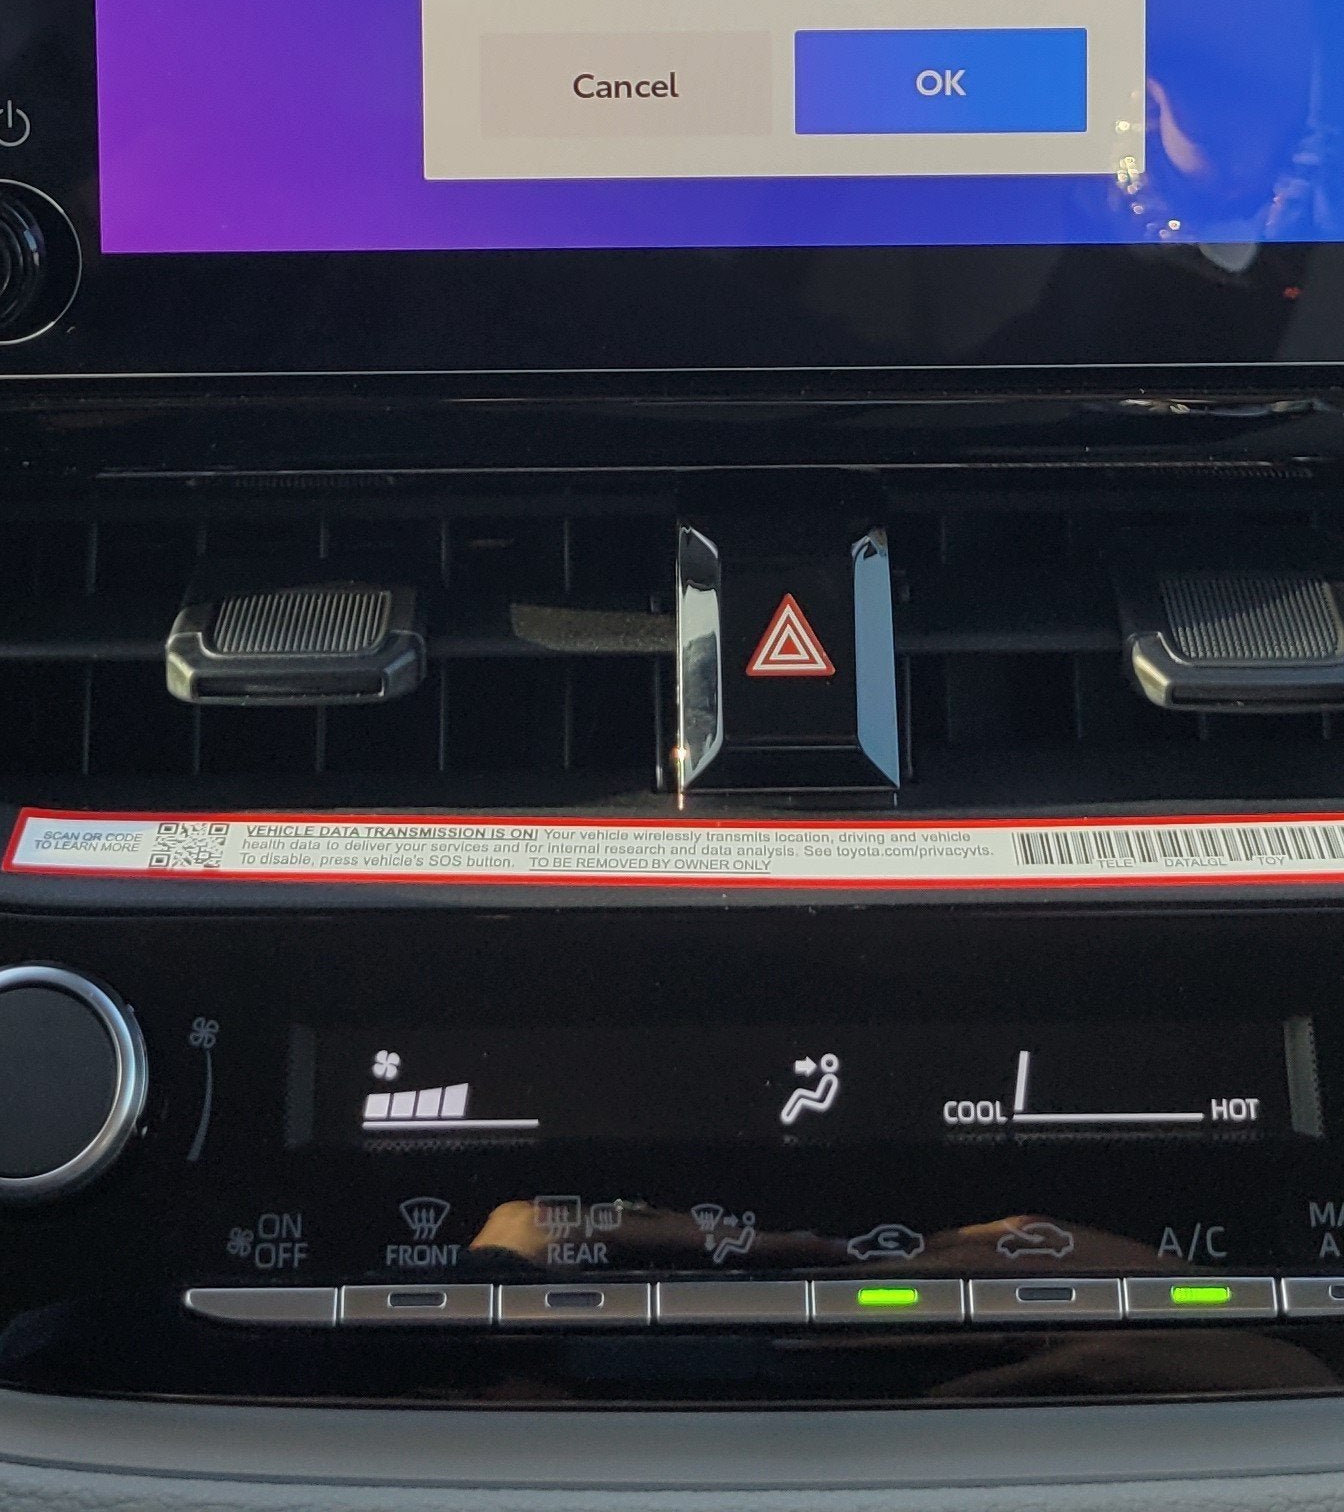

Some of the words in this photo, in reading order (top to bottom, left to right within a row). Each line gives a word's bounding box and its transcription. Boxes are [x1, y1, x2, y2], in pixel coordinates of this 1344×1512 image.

[573, 71, 680, 99] Cancel
[915, 68, 967, 97] OK
[34, 839, 52, 850] TO
[54, 840, 98, 851] LEARN
[100, 841, 140, 852] MORE
[43, 830, 81, 841] SCAN
[83, 831, 102, 841] QR
[105, 832, 143, 843] CODE
[247, 825, 315, 837] VEHICLE
[319, 826, 360, 838] DATA
[366, 827, 486, 839] TRANSMISSION
[491, 828, 506, 839] IS
[544, 829, 576, 840] Your
[579, 829, 629, 841] vehicle
[633, 830, 702, 843] wirelessly
[705, 831, 770, 843] transmits
[774, 831, 835, 845] location,
[839, 831, 886, 845] driving
[890, 831, 916, 843] and
[921, 830, 971, 843] vehicle
[242, 838, 286, 850] health
[289, 839, 321, 850] data
[326, 840, 339, 851] to
[344, 839, 390, 851] deliver
[395, 842, 426, 854] your
[430, 842, 489, 853] services
[493, 842, 520, 853] and
[524, 842, 544, 853] for
[547, 843, 600, 854] internal
[604, 843, 666, 855] research
[670, 844, 697, 855] and
[701, 844, 732, 856] data
[737, 844, 799, 858] analysis.
[803, 845, 833, 857] See
[240, 852, 256, 865] To
[260, 852, 316, 867] disable,
[319, 854, 359, 867] press
[364, 854, 424, 867] vehicle's
[429, 855, 462, 867] SOS
[467, 855, 515, 868] button.
[529, 857, 549, 868] TO
[553, 857, 573, 868] BE
[576, 858, 648, 869] REMOVED
[651, 858, 671, 869] BY
[674, 858, 731, 870] OWNER
[733, 859, 772, 870] ONLY
[1097, 858, 1134, 869] TELE
[1256, 855, 1286, 866] TOY
[943, 1100, 1008, 1125] COOL
[1210, 1097, 1260, 1122] HOT
[257, 1213, 303, 1240] ON
[547, 1242, 609, 1265] REAR
[1157, 1222, 1228, 1262] A/C
[254, 1241, 309, 1269] OFF
[385, 1244, 461, 1267] FRONT
